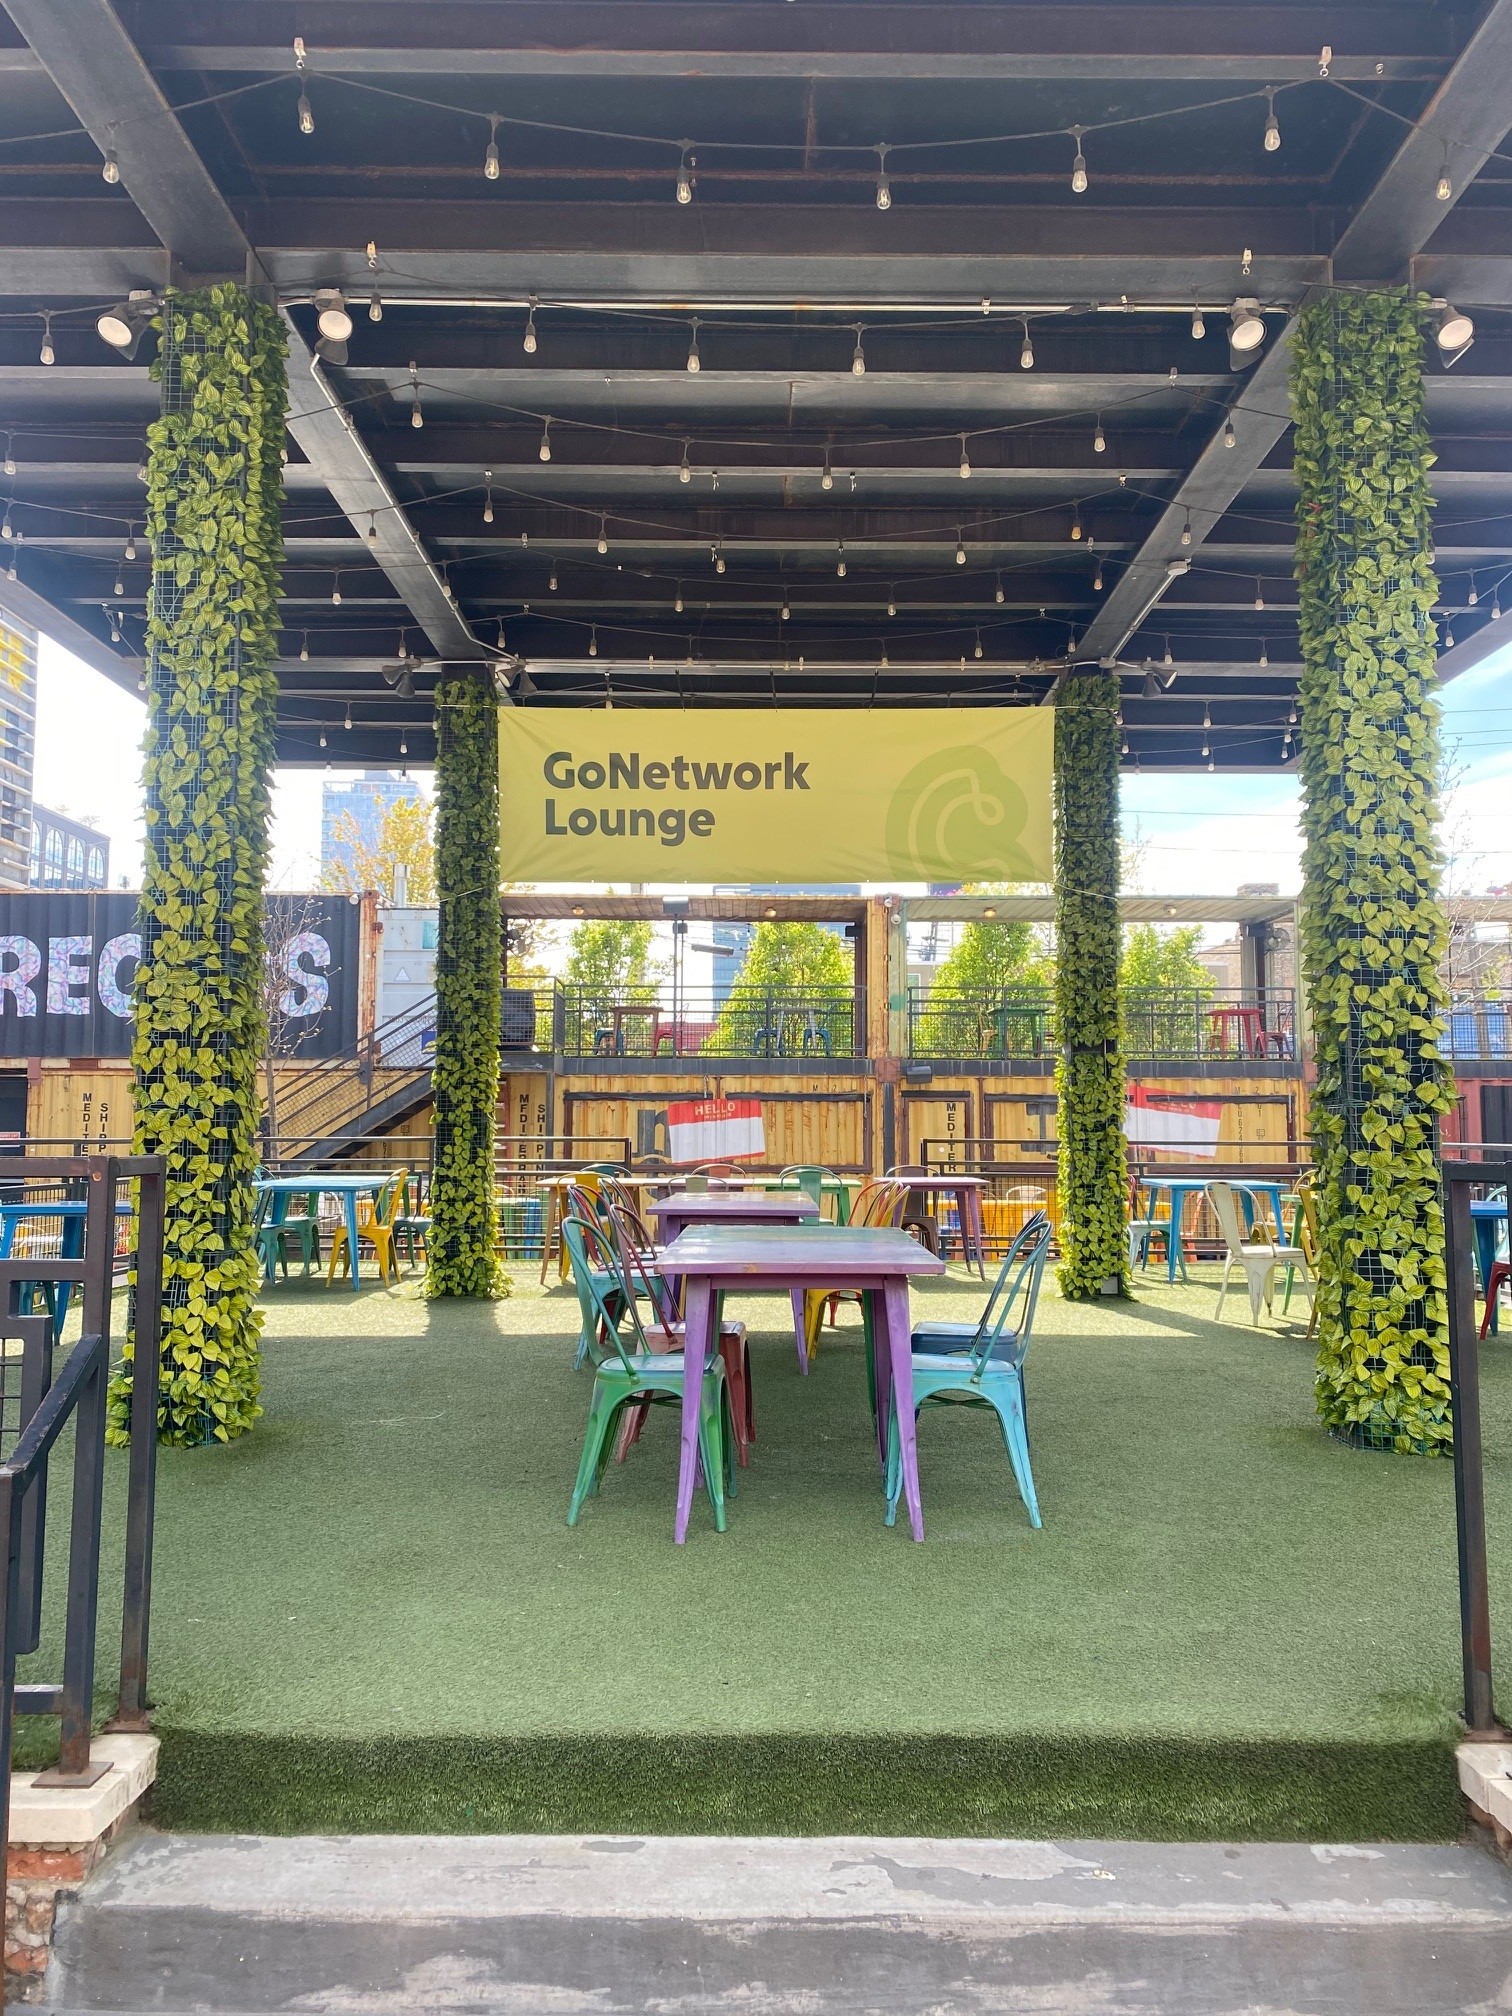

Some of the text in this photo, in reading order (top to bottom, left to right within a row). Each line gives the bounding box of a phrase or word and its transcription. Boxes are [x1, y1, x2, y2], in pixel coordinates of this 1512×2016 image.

[543, 751, 811, 791] GoNetwork
[545, 798, 716, 847] Lounge
[694, 1102, 736, 1116] HELLO
